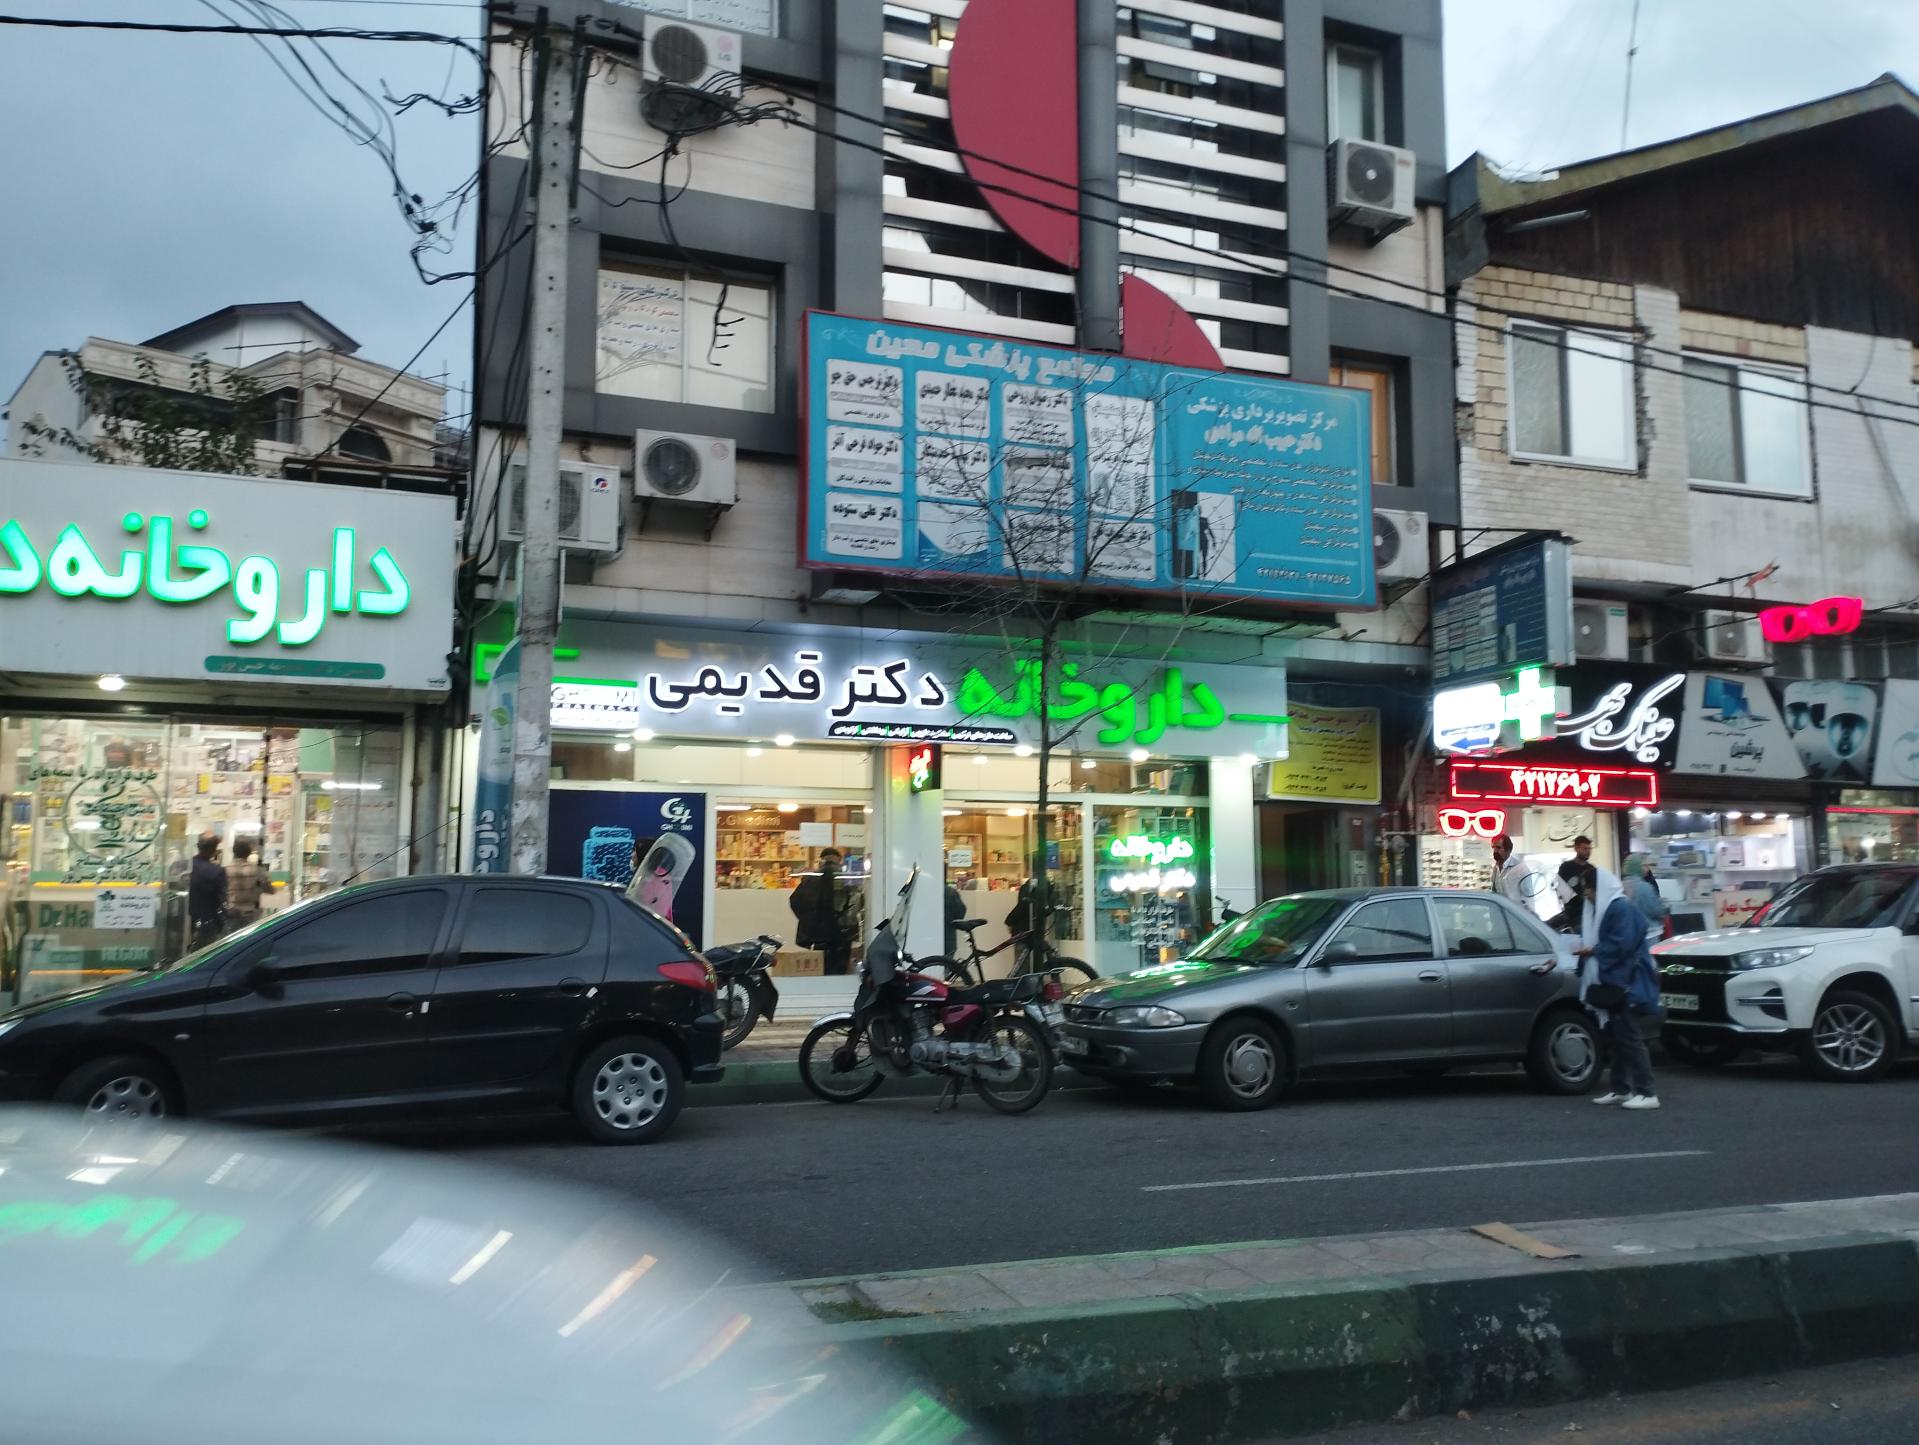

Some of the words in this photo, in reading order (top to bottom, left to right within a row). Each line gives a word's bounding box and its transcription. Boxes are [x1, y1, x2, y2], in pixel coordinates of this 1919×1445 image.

[865, 329, 940, 360] معین
[945, 340, 1031, 380] پزشکی
[1037, 353, 1116, 385] مجتمع
[1294, 431, 1323, 455] دکتر
[47, 508, 412, 645] داروخانه
[648, 649, 825, 716] قدیمی
[825, 656, 949, 719] دکتر
[955, 659, 1226, 744] داروخانه
